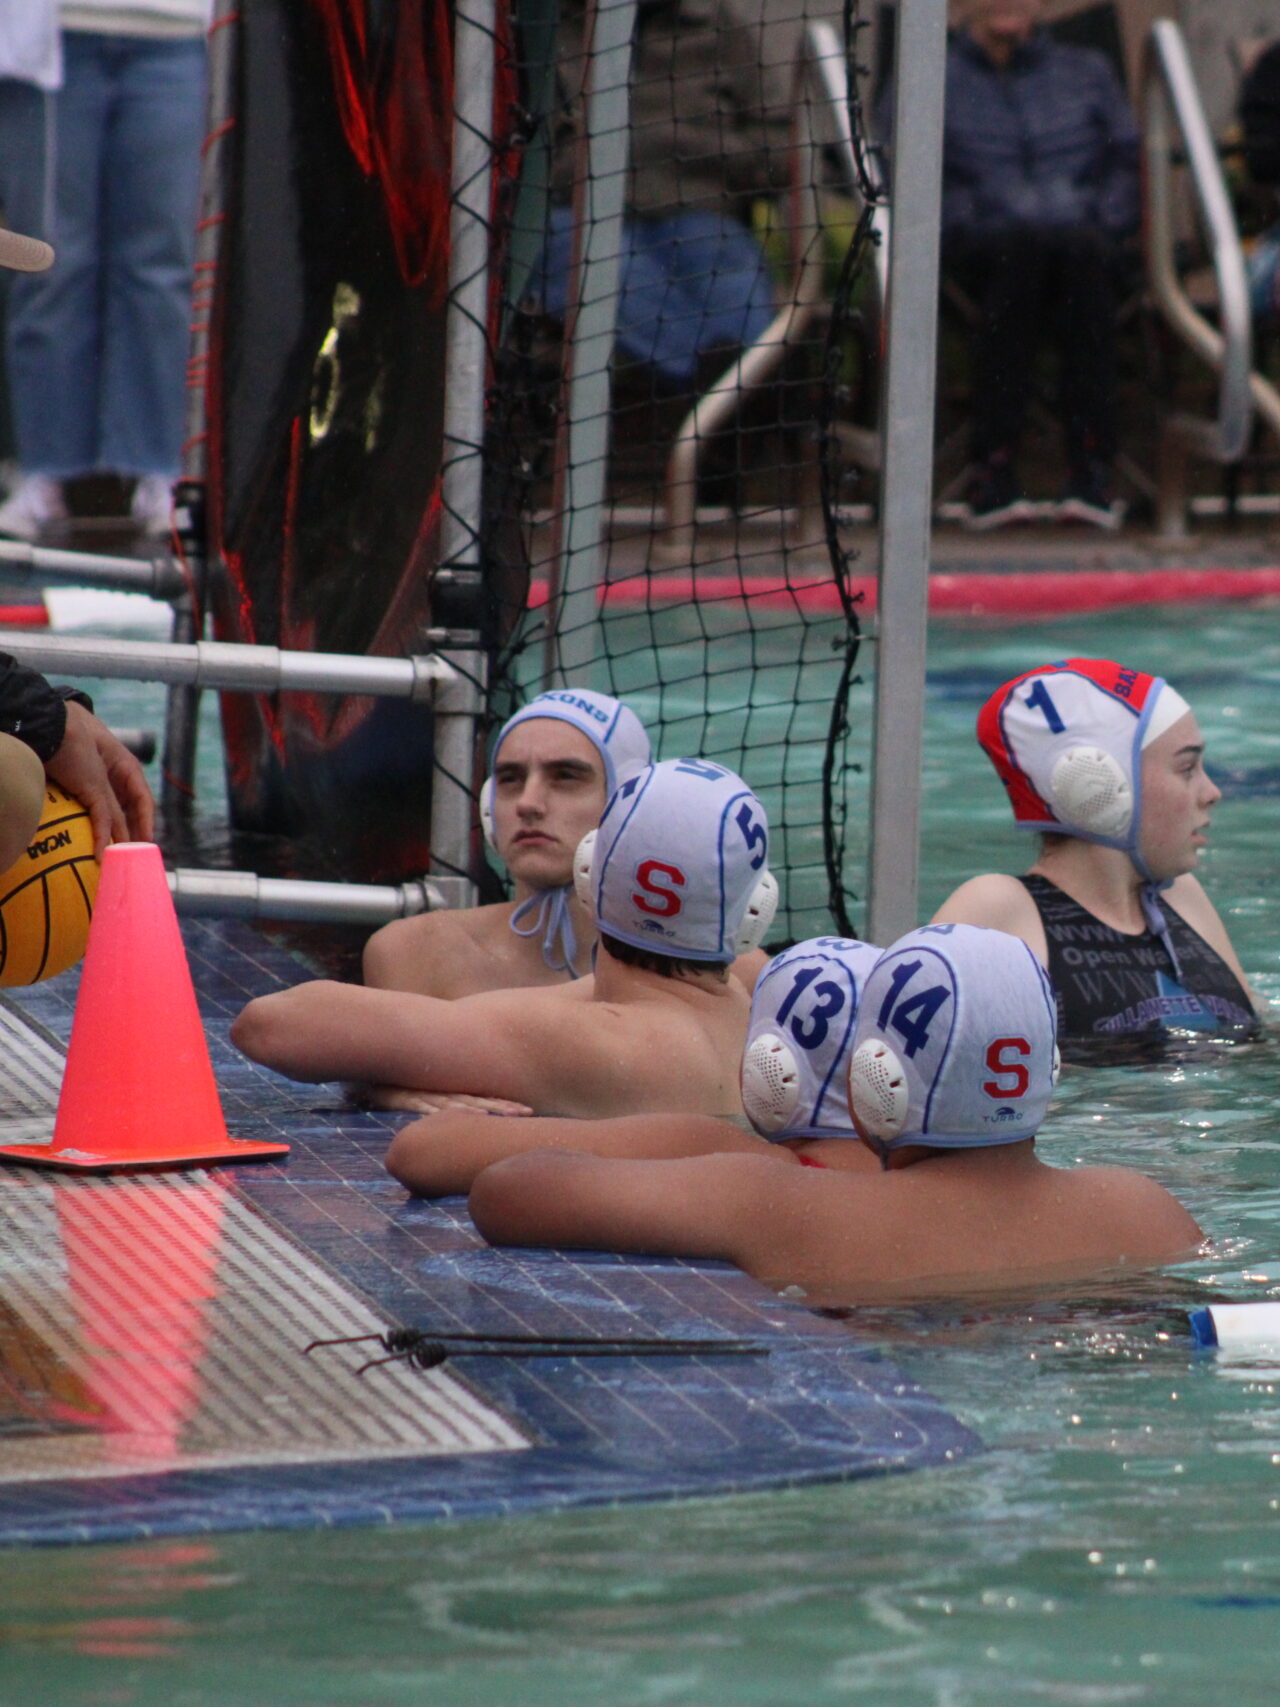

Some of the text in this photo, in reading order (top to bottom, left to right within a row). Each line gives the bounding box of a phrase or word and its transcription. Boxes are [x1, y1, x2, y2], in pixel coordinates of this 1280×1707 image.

[539, 693, 609, 722] XONS
[1024, 679, 1066, 735] 1
[26, 830, 72, 860] NCAA
[736, 802, 767, 871] 5
[632, 860, 686, 918] S
[1061, 946, 1131, 968] Open
[775, 966, 846, 1050] 13
[877, 959, 951, 1059] 14
[983, 1037, 1032, 1099] S
